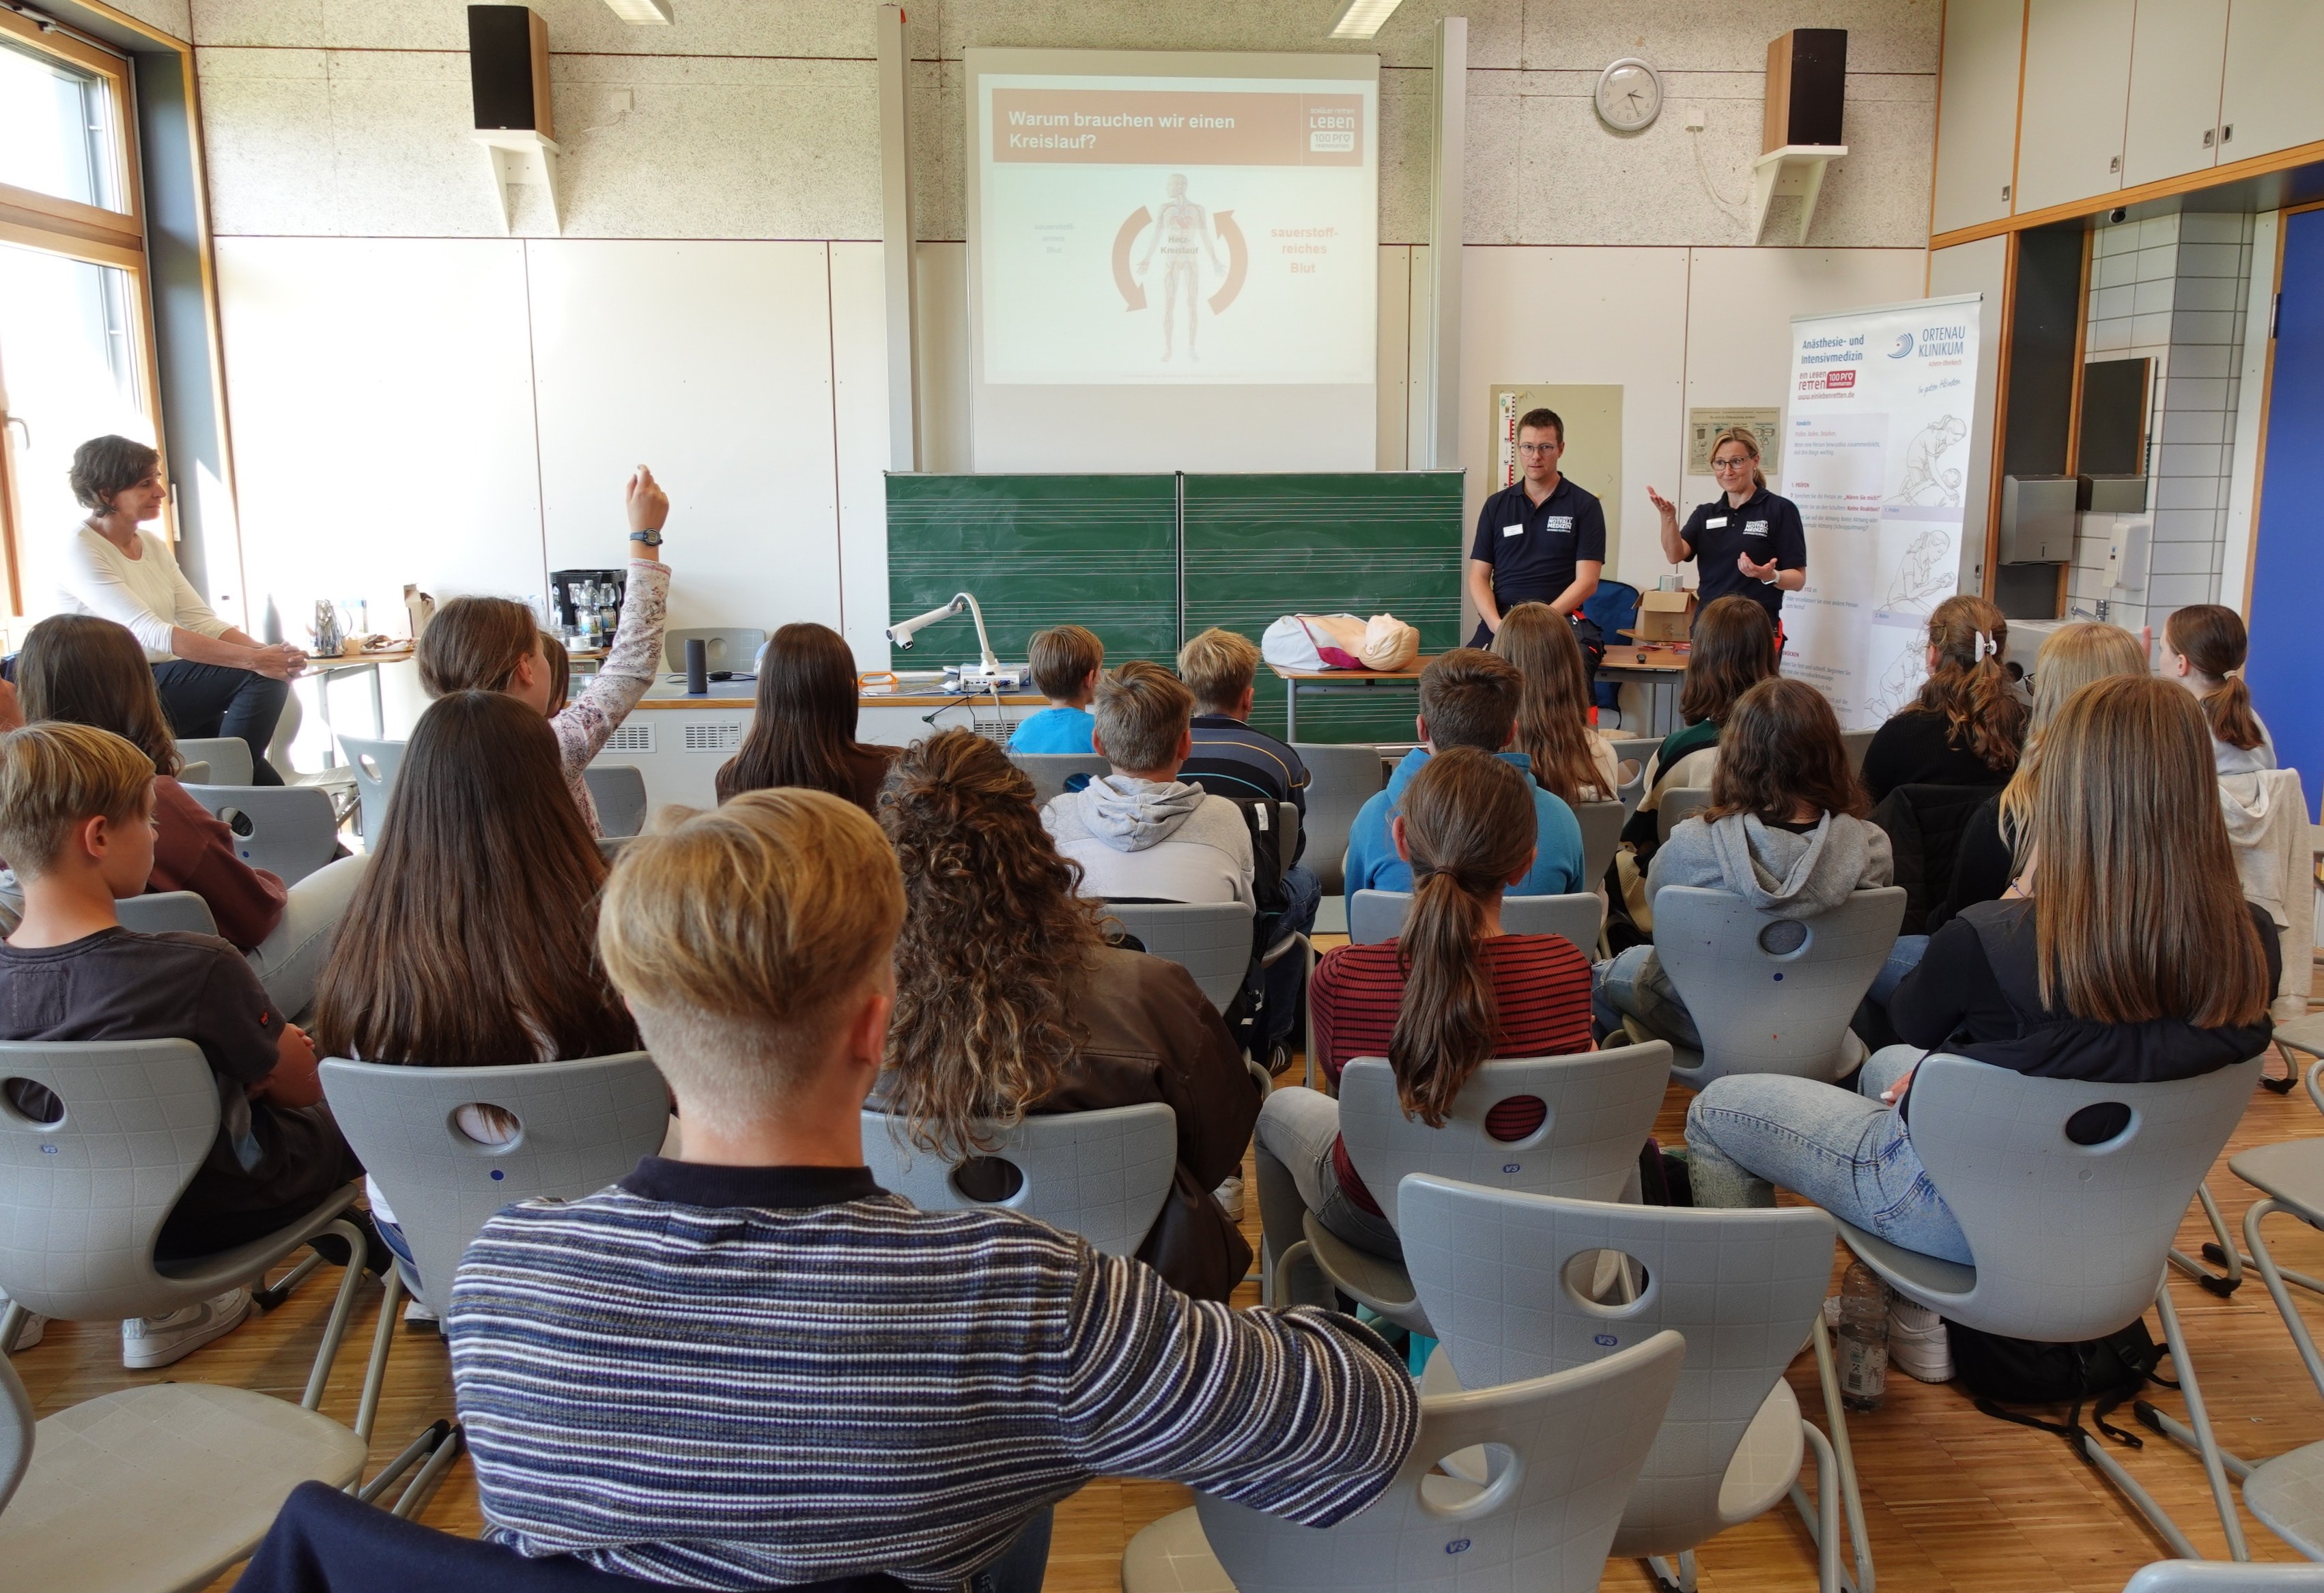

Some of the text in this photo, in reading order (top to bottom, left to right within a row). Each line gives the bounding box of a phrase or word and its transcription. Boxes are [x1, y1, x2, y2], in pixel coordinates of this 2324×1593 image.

[1008, 111, 1235, 129] Warum brauchen wir einen
[1009, 134, 1096, 149] Kreislauf?
[1271, 227, 1339, 238] sauerstoff-
[1160, 246, 1199, 255] Kreislauf
[1282, 243, 1327, 254] reiches
[1290, 262, 1316, 274] Blut
[1923, 326, 1966, 342] ORTENAU
[1802, 334, 1864, 349] Anästhesie- und
[1918, 341, 1964, 358] KLINIKUM
[1801, 350, 1863, 364] Intensivmedizin
[1798, 392, 1855, 400] www.einlebenretten.de
